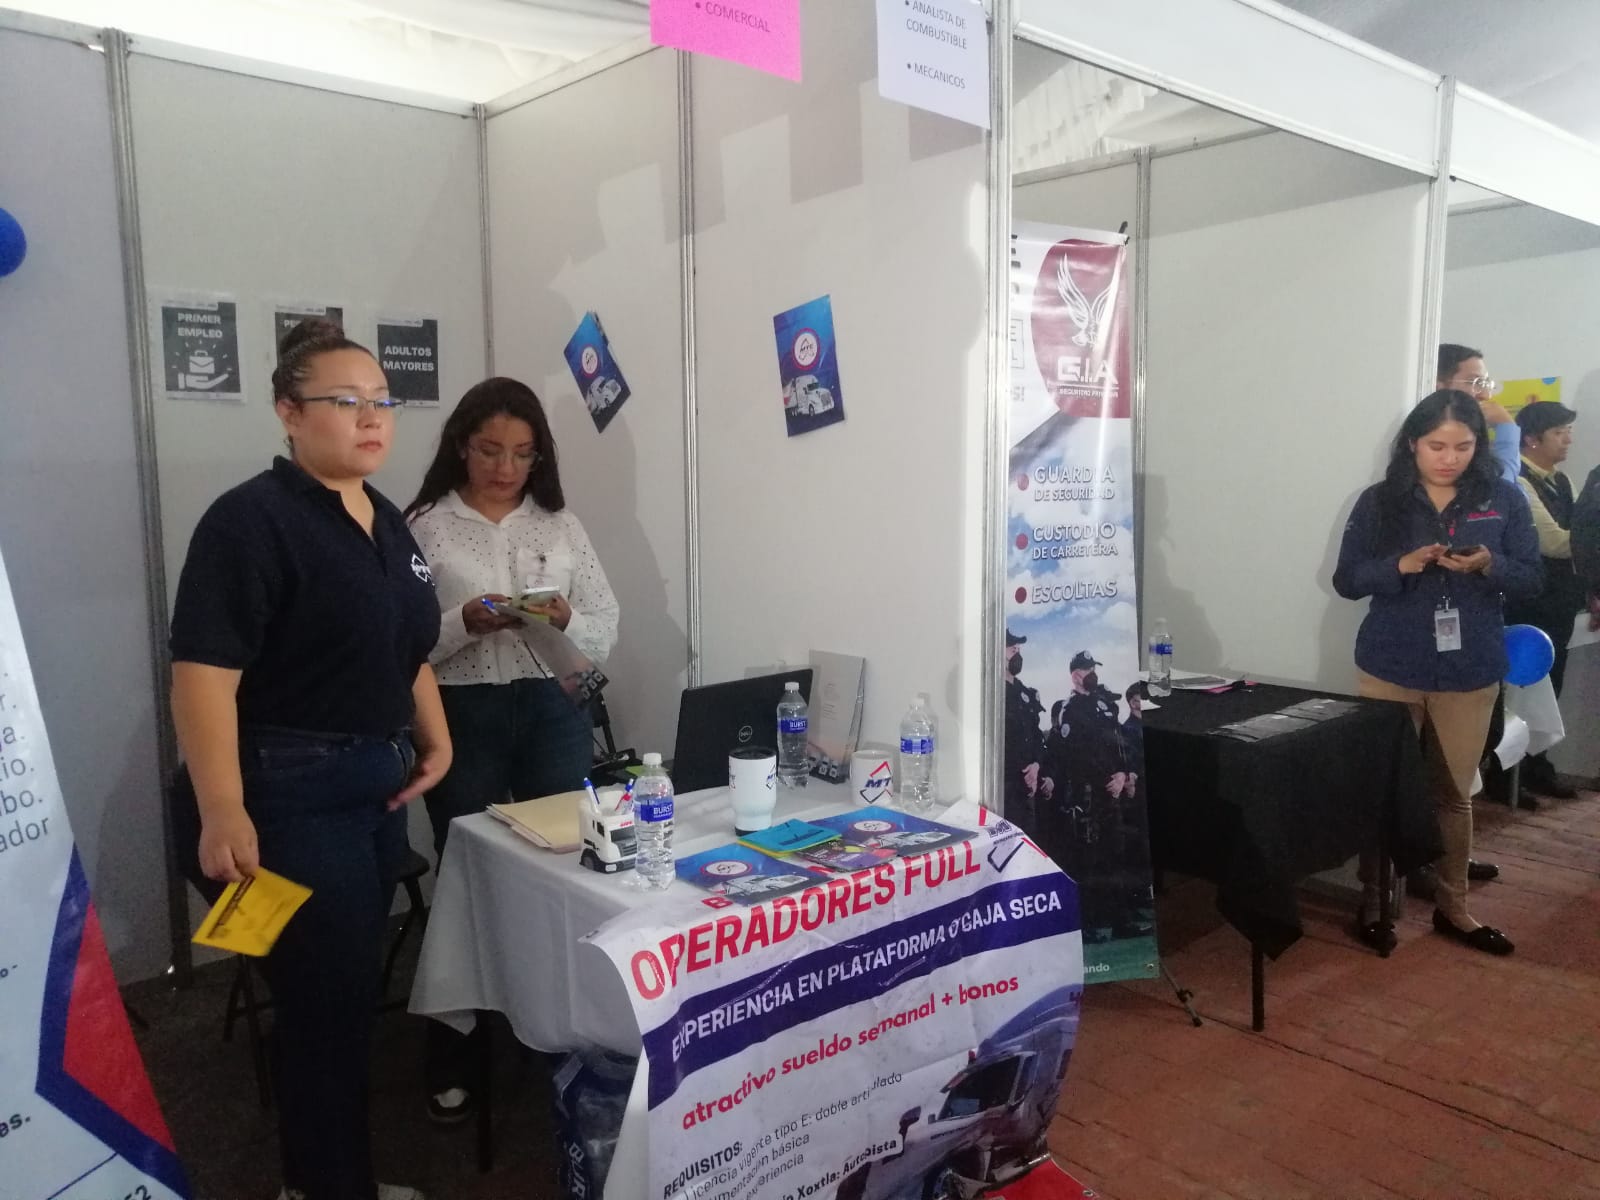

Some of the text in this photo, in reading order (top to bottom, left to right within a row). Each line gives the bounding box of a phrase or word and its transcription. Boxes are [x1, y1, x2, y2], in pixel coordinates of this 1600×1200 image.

[705, 1, 770, 33] COMERCIAL
[912, 0, 967, 30] ANALISTA DE
[906, 18, 967, 50] COMBUSTIBLE
[914, 63, 966, 89] MECANICOS
[177, 312, 221, 326] PRIMER
[177, 327, 223, 339] EMPLEO
[384, 345, 432, 358] ADULTOS
[382, 360, 434, 372] MAYORES
[1034, 464, 1116, 485] GUARDA
[1034, 489, 1050, 502] DE
[1033, 522, 1117, 542] CUSTODIO
[1032, 543, 1119, 561] DE CARRETERA
[1031, 580, 1118, 605] ESCOLTAS
[653, 803, 673, 815] BURST
[630, 840, 981, 1001] OPERADORES FULL
[672, 982, 794, 1063] EXPERIENCIA
[798, 972, 823, 998] EN
[827, 925, 945, 986] PLATAFORMA
[962, 902, 1007, 933] CAJA
[1010, 891, 1062, 920] SECA
[682, 976, 1019, 1130] atractivo sueldo semanal + bonos
[774, 1120, 798, 1141] tipo
[815, 1099, 848, 1121] doble
[851, 1072, 902, 1106] artilado
[772, 1133, 810, 1161] básica
[663, 1140, 744, 1200] REQUISITOS:
